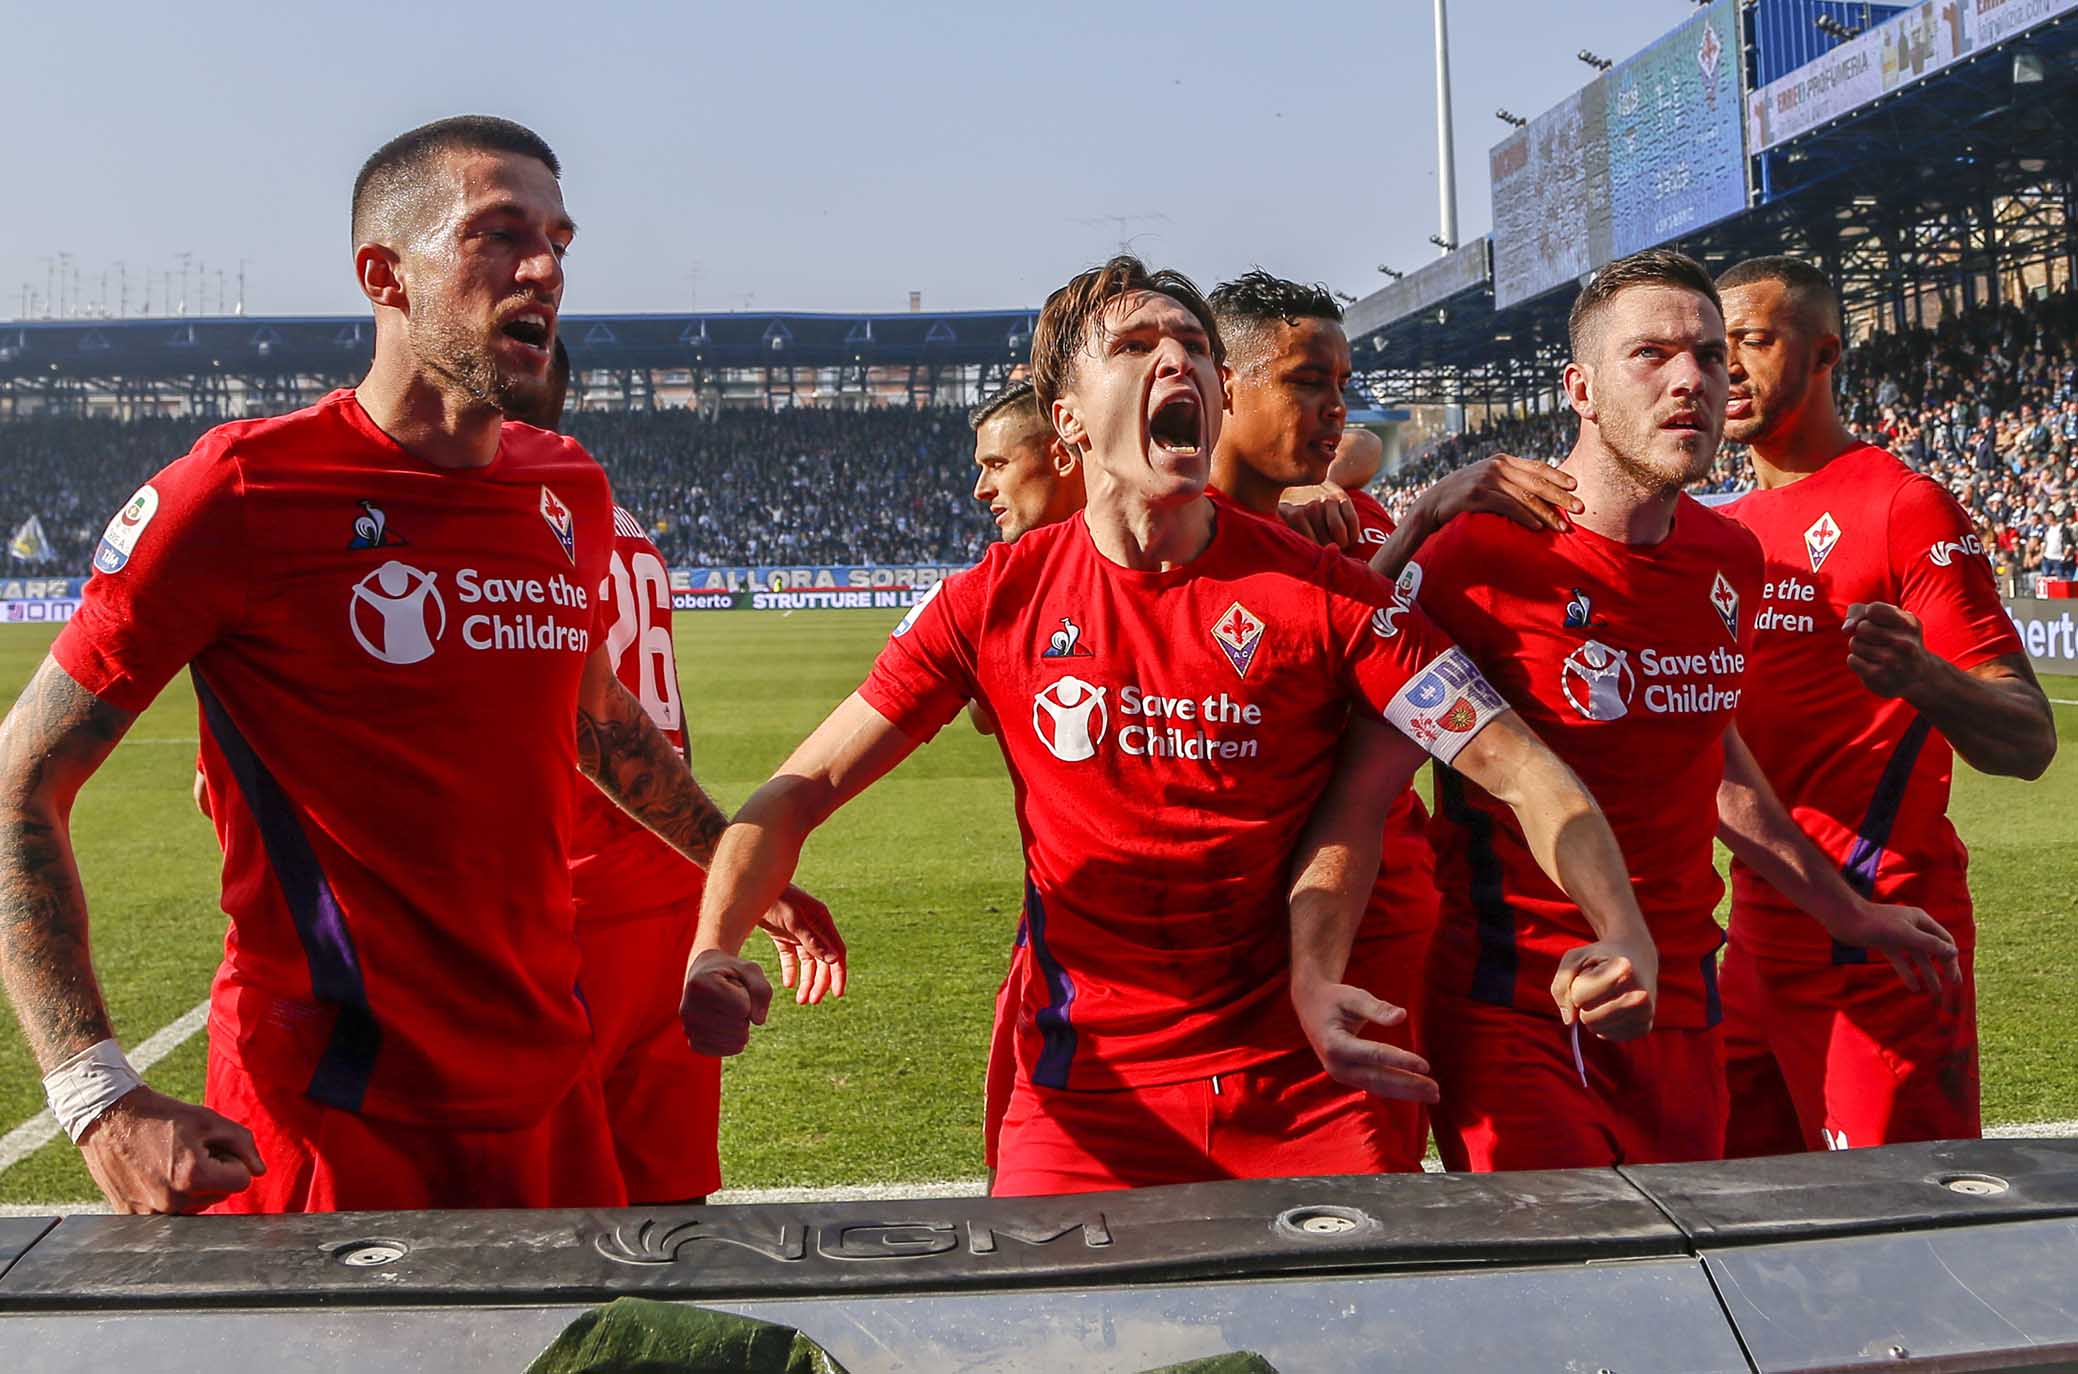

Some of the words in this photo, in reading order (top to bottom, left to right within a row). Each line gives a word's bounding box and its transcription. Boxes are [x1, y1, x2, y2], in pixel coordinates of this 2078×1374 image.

[102, 547, 120, 568] TIM
[456, 568, 545, 604] Save
[548, 574, 588, 610] the
[703, 569, 836, 590] ALLORA
[1777, 577, 1815, 601] the
[752, 592, 872, 610] STRUTTURE
[875, 591, 897, 608] IN
[462, 614, 588, 654] Children
[1754, 606, 1814, 633] ldren
[598, 550, 682, 731] 26
[1640, 648, 1707, 676] Save
[1709, 646, 1745, 675] the
[1120, 685, 1197, 721] Save
[1202, 693, 1263, 725] the
[1118, 725, 1259, 761] Children
[595, 1215, 1114, 1267] NGM
